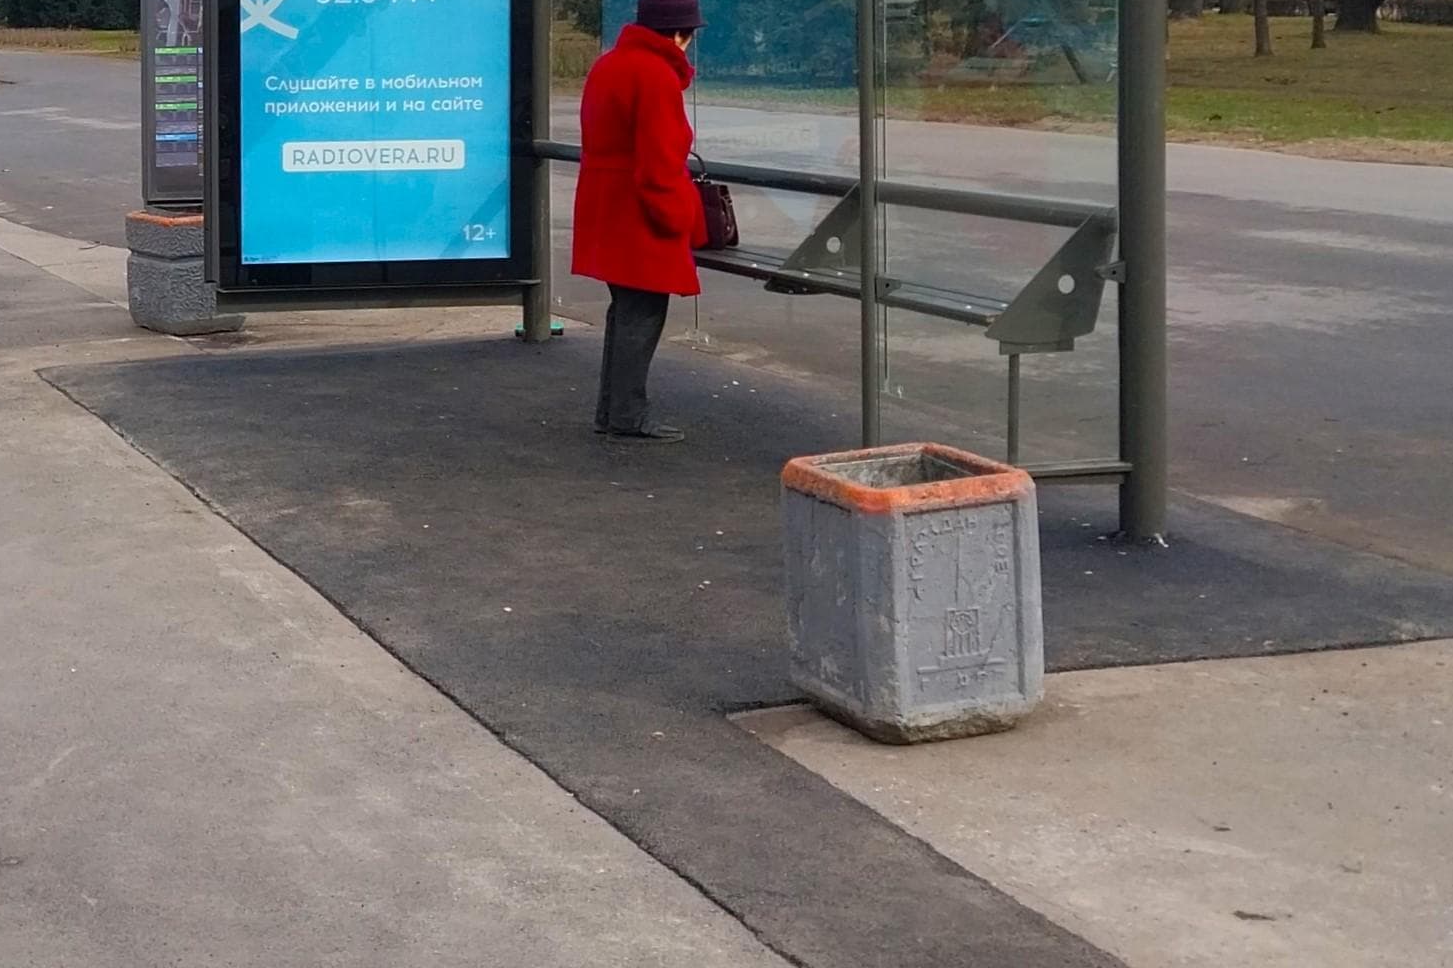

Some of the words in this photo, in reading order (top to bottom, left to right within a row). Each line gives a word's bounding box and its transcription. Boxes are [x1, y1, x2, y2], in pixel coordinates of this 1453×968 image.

[265, 76, 359, 94] Слушайте
[365, 77, 375, 89] в
[381, 74, 483, 89] мобильном
[264, 100, 380, 116] приложении
[386, 100, 397, 112] и
[403, 98, 425, 112] на
[431, 96, 484, 111] сайте
[292, 147, 456, 165] RADIOVERA.RU
[462, 224, 497, 241] 12+
